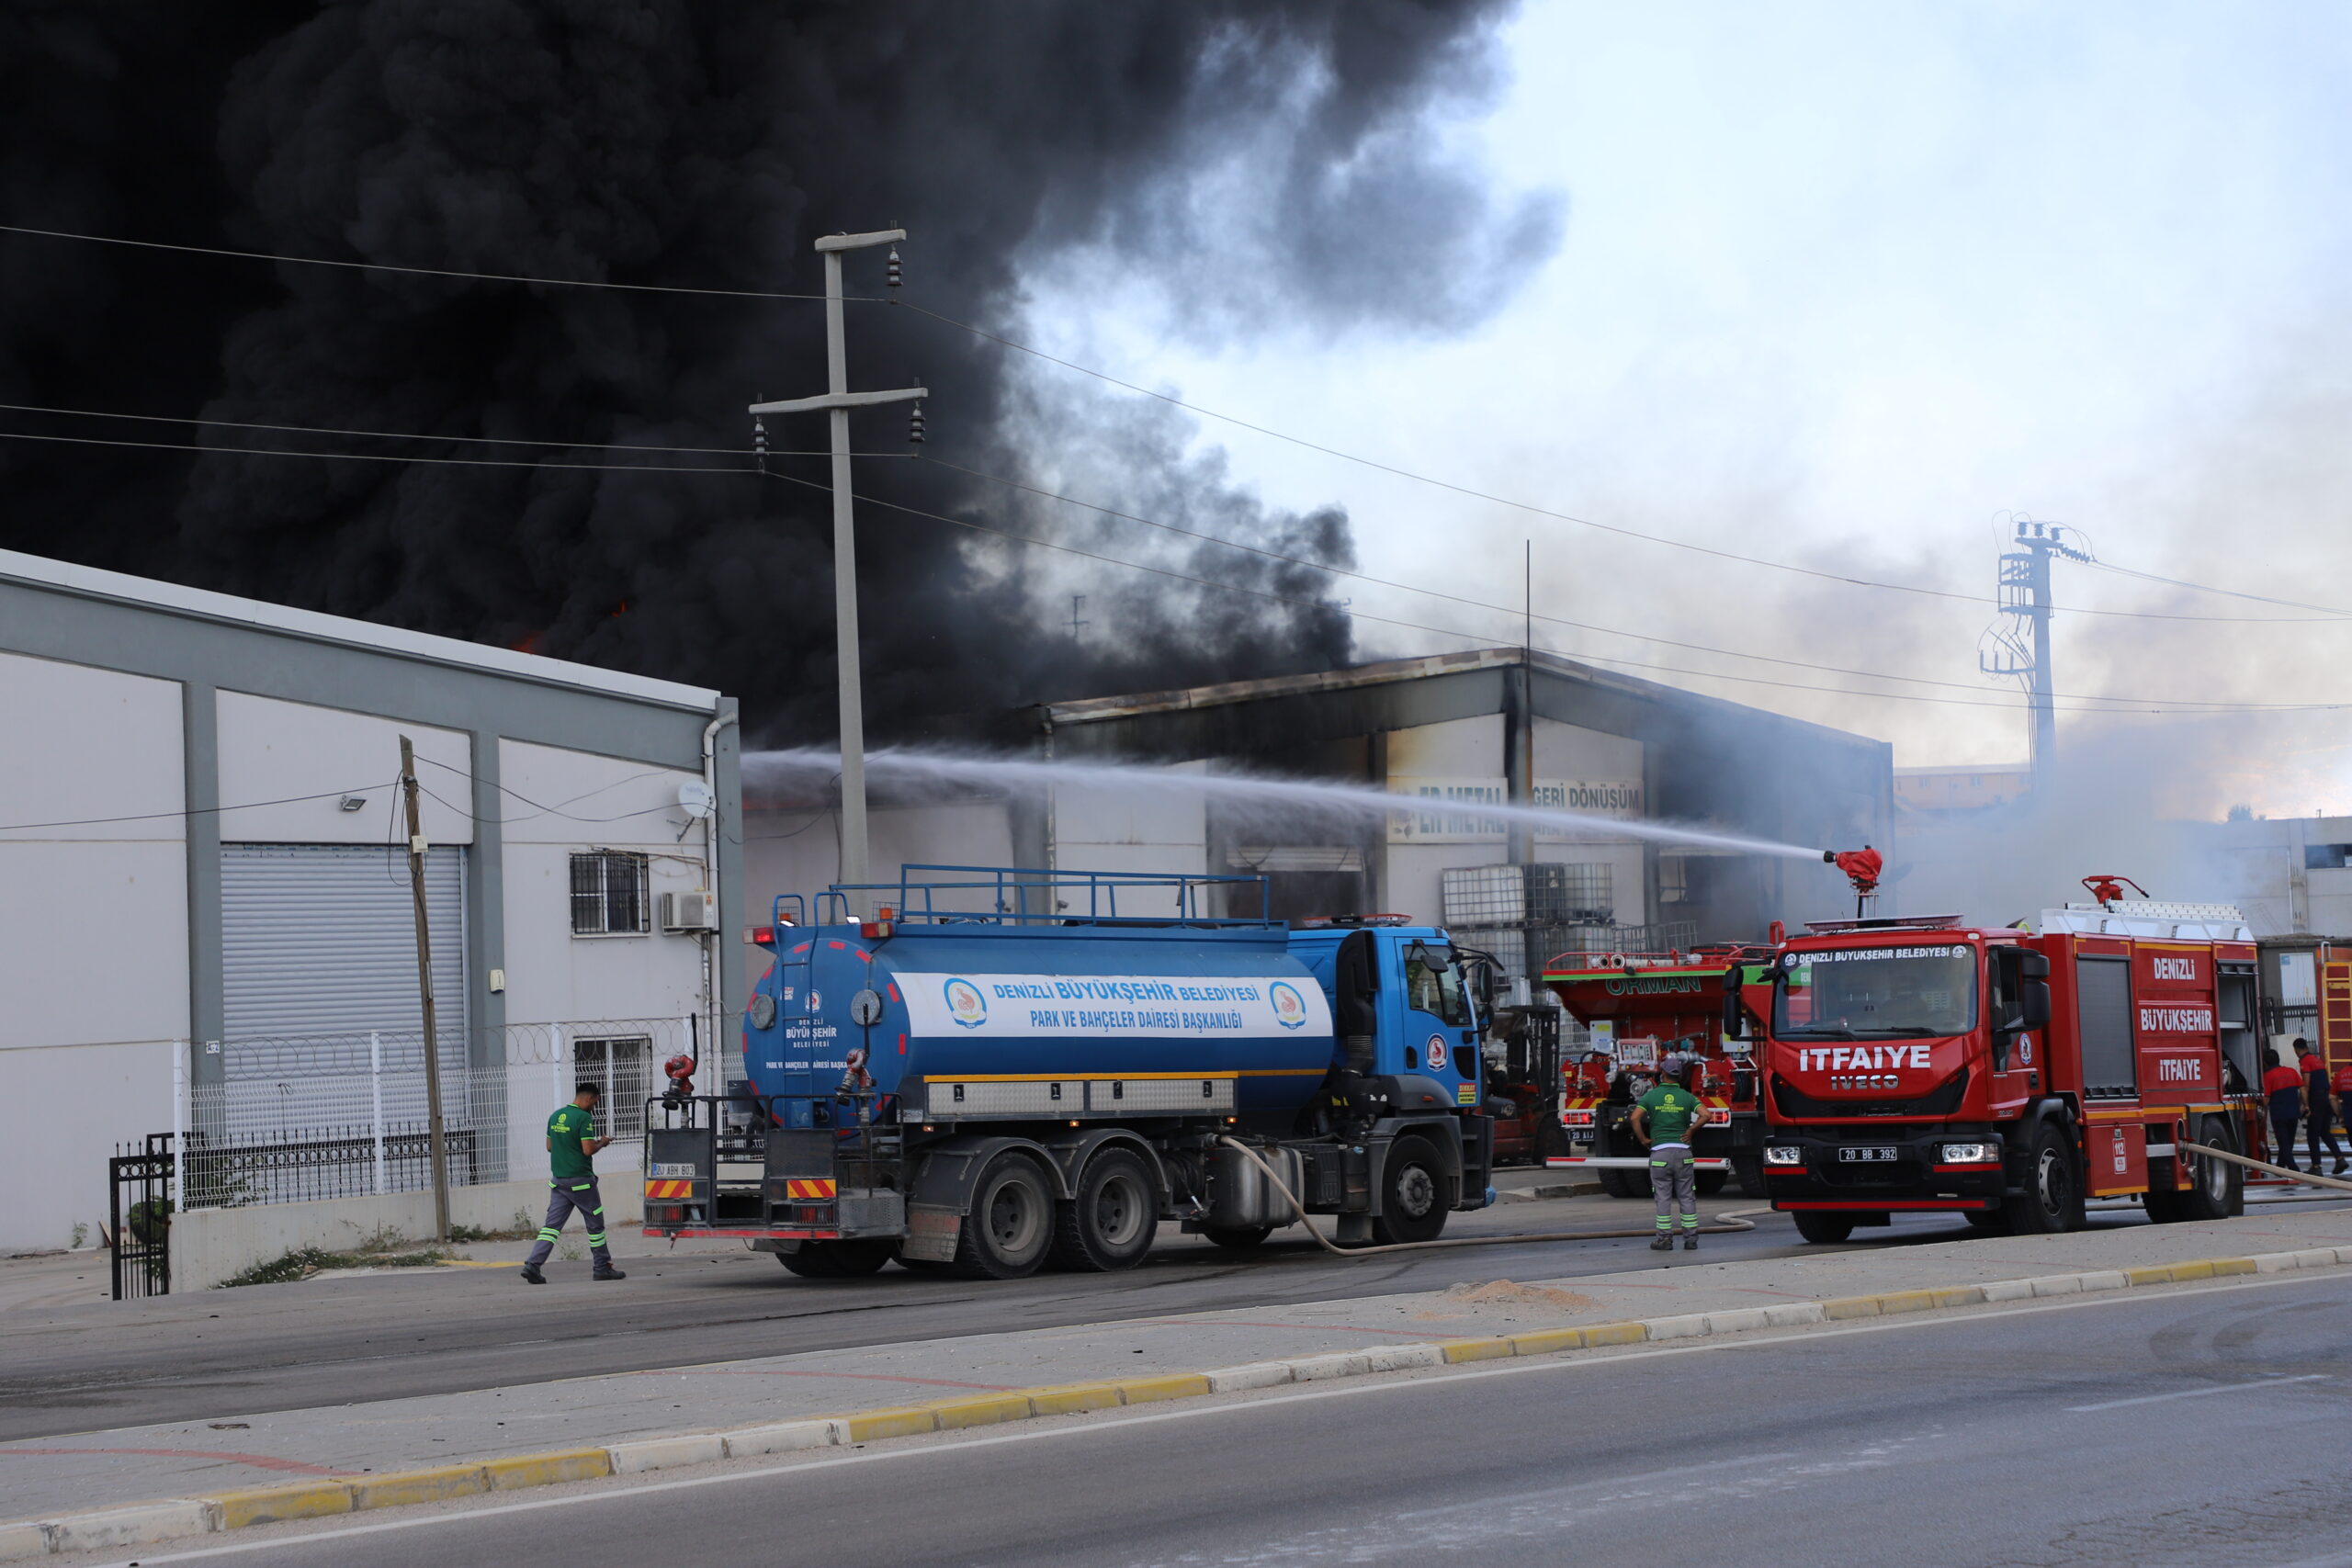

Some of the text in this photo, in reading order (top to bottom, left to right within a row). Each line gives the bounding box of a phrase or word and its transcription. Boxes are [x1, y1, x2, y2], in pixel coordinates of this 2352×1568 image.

[1532, 783, 1639, 815] GERİ DÖNÜŞÜM
[1799, 947, 1950, 964] DENİZLİ BÜYÜKŞEHİR BELEDİYESİ
[2154, 957, 2195, 980] DENİZLİ
[992, 979, 1261, 1004] DENİZLİ BÜYÜKŞEHİR BELEDİYESİ
[1605, 976, 1702, 996] ORMAN
[798, 1017, 823, 1025] DENZLİ
[1030, 1008, 1242, 1032] PARK VE BAHÇELER DAİRESİ BAŞKANLIĞI
[2141, 1009, 2212, 1033] BÜYÜKŞEHİR
[812, 1059, 830, 1069] AİRESİ
[1800, 1045, 1931, 1072] İTFAİYE
[2160, 1059, 2201, 1080] İTFAİYE
[1831, 1075, 1899, 1090] IVECO
[1845, 1148, 1895, 1160] 20 BB 392
[2114, 1142, 2125, 1156] 112
